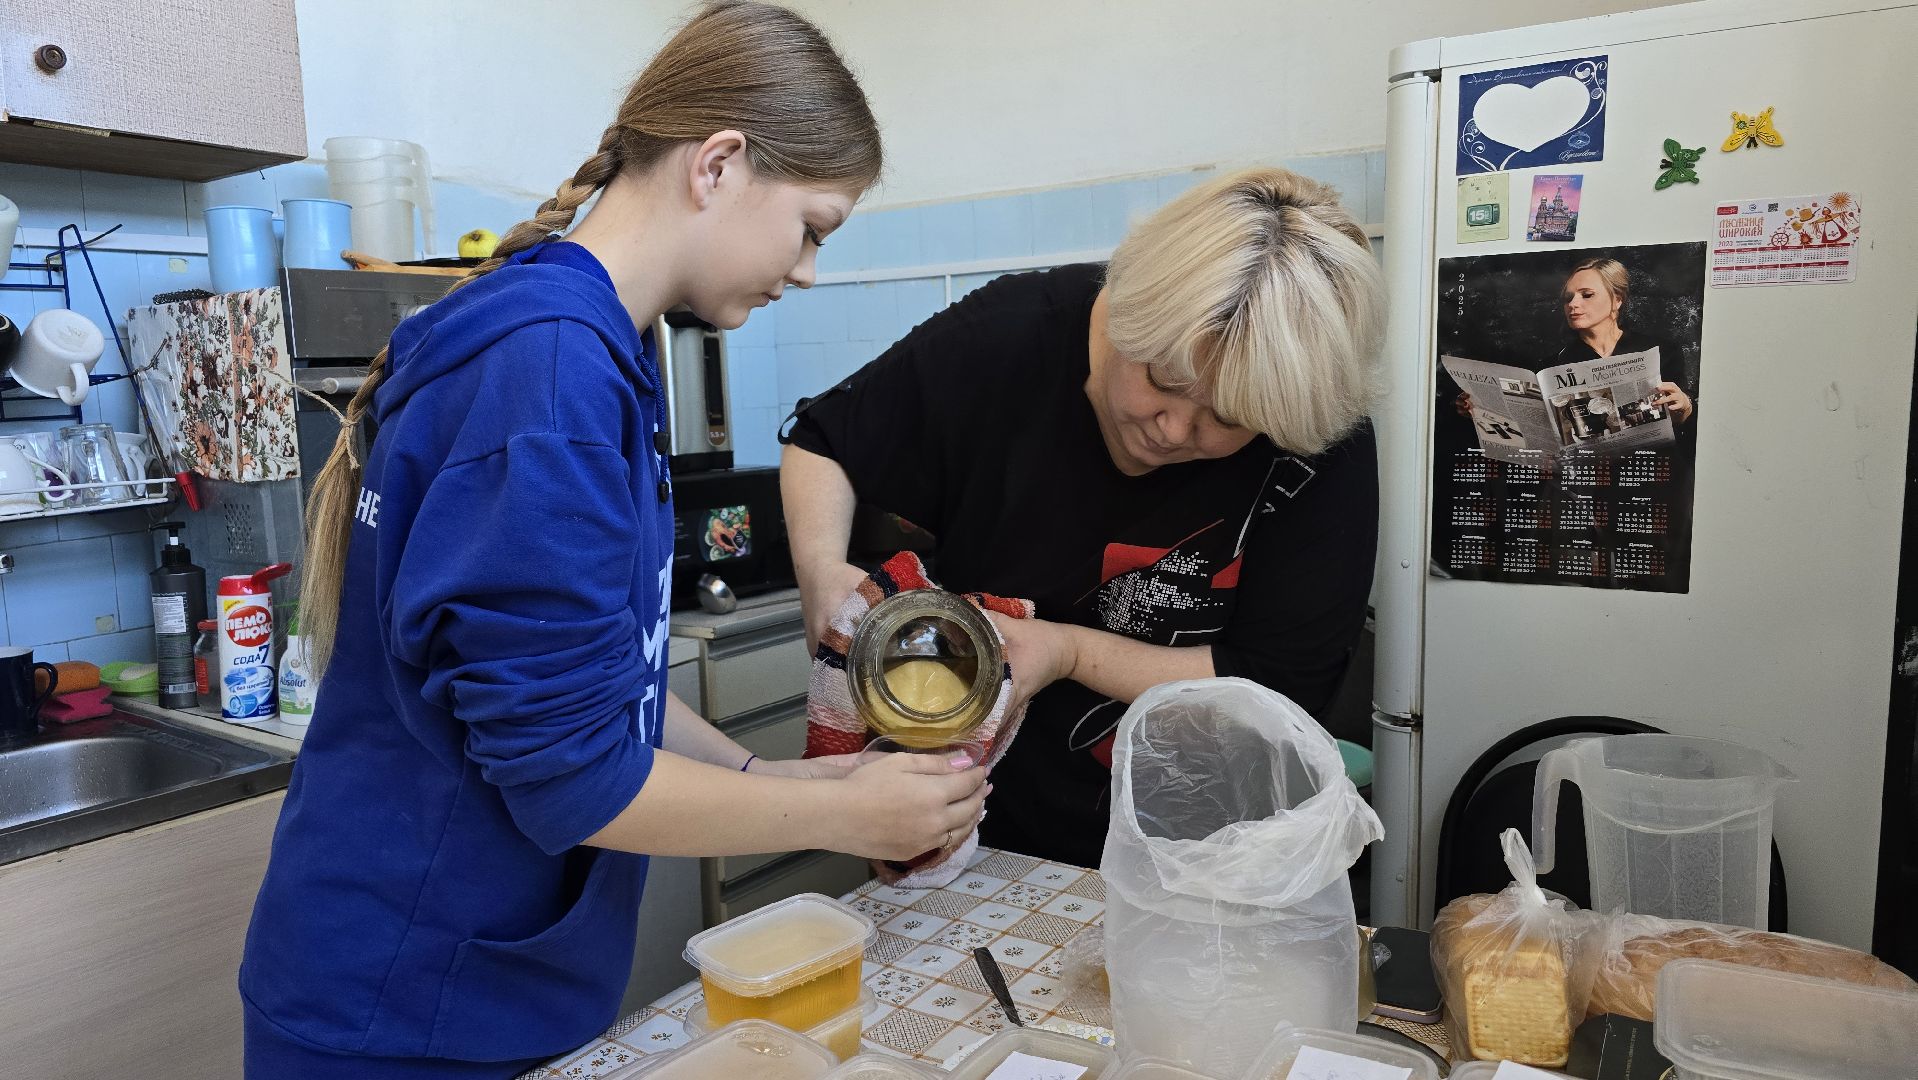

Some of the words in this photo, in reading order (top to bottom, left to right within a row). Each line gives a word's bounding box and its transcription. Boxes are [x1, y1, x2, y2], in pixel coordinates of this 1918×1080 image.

[1470, 210, 1485, 222] 15
[1718, 226, 1763, 238] ШИРОКАЯ
[225, 610, 267, 631] ПЕМО
[233, 653, 260, 666] СОДА
[258, 643, 270, 664] 7
[280, 676, 307, 688] Absolut
